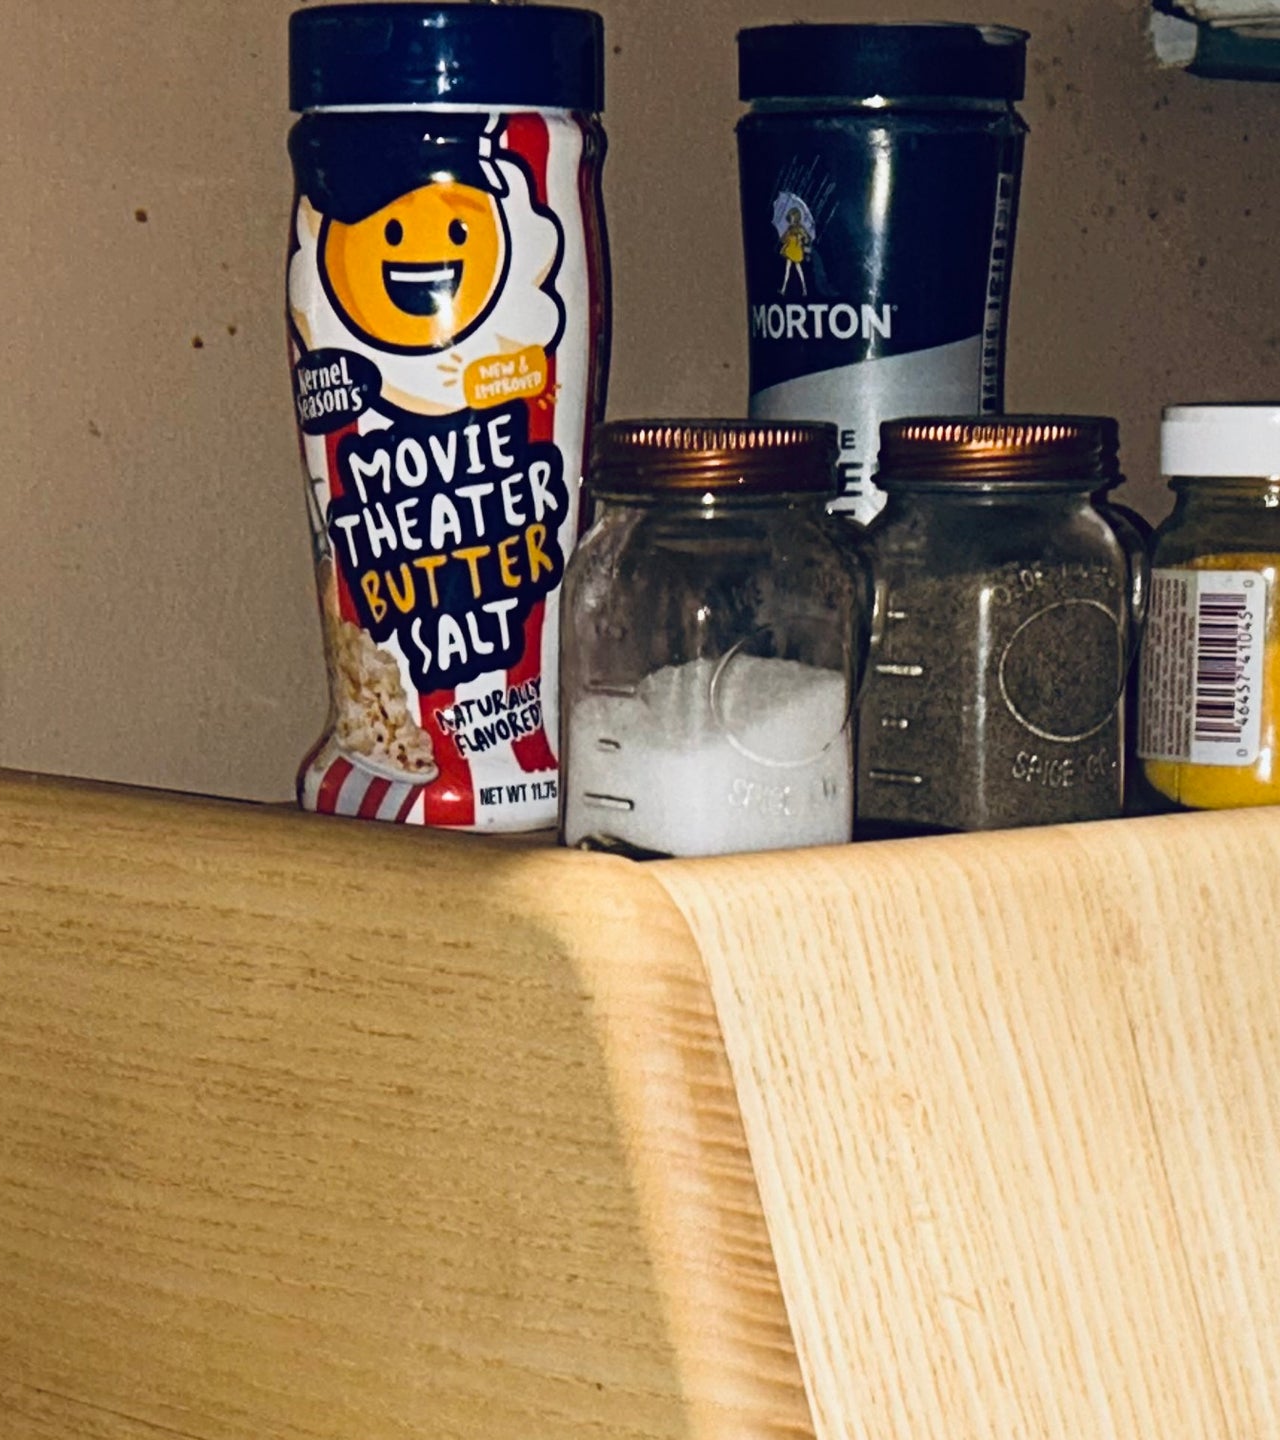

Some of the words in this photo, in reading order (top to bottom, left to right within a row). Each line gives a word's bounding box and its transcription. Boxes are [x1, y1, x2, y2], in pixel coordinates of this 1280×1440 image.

[753, 303, 891, 339] MORTON
[348, 413, 516, 503] MOVIE
[334, 461, 559, 568] THEATER
[361, 523, 553, 623] BUTTER
[411, 597, 519, 674] SALT
[434, 677, 541, 731] NATURALLY
[454, 704, 541, 757] FLAVORED
[479, 786, 503, 806] NET
[506, 784, 527, 804] WT
